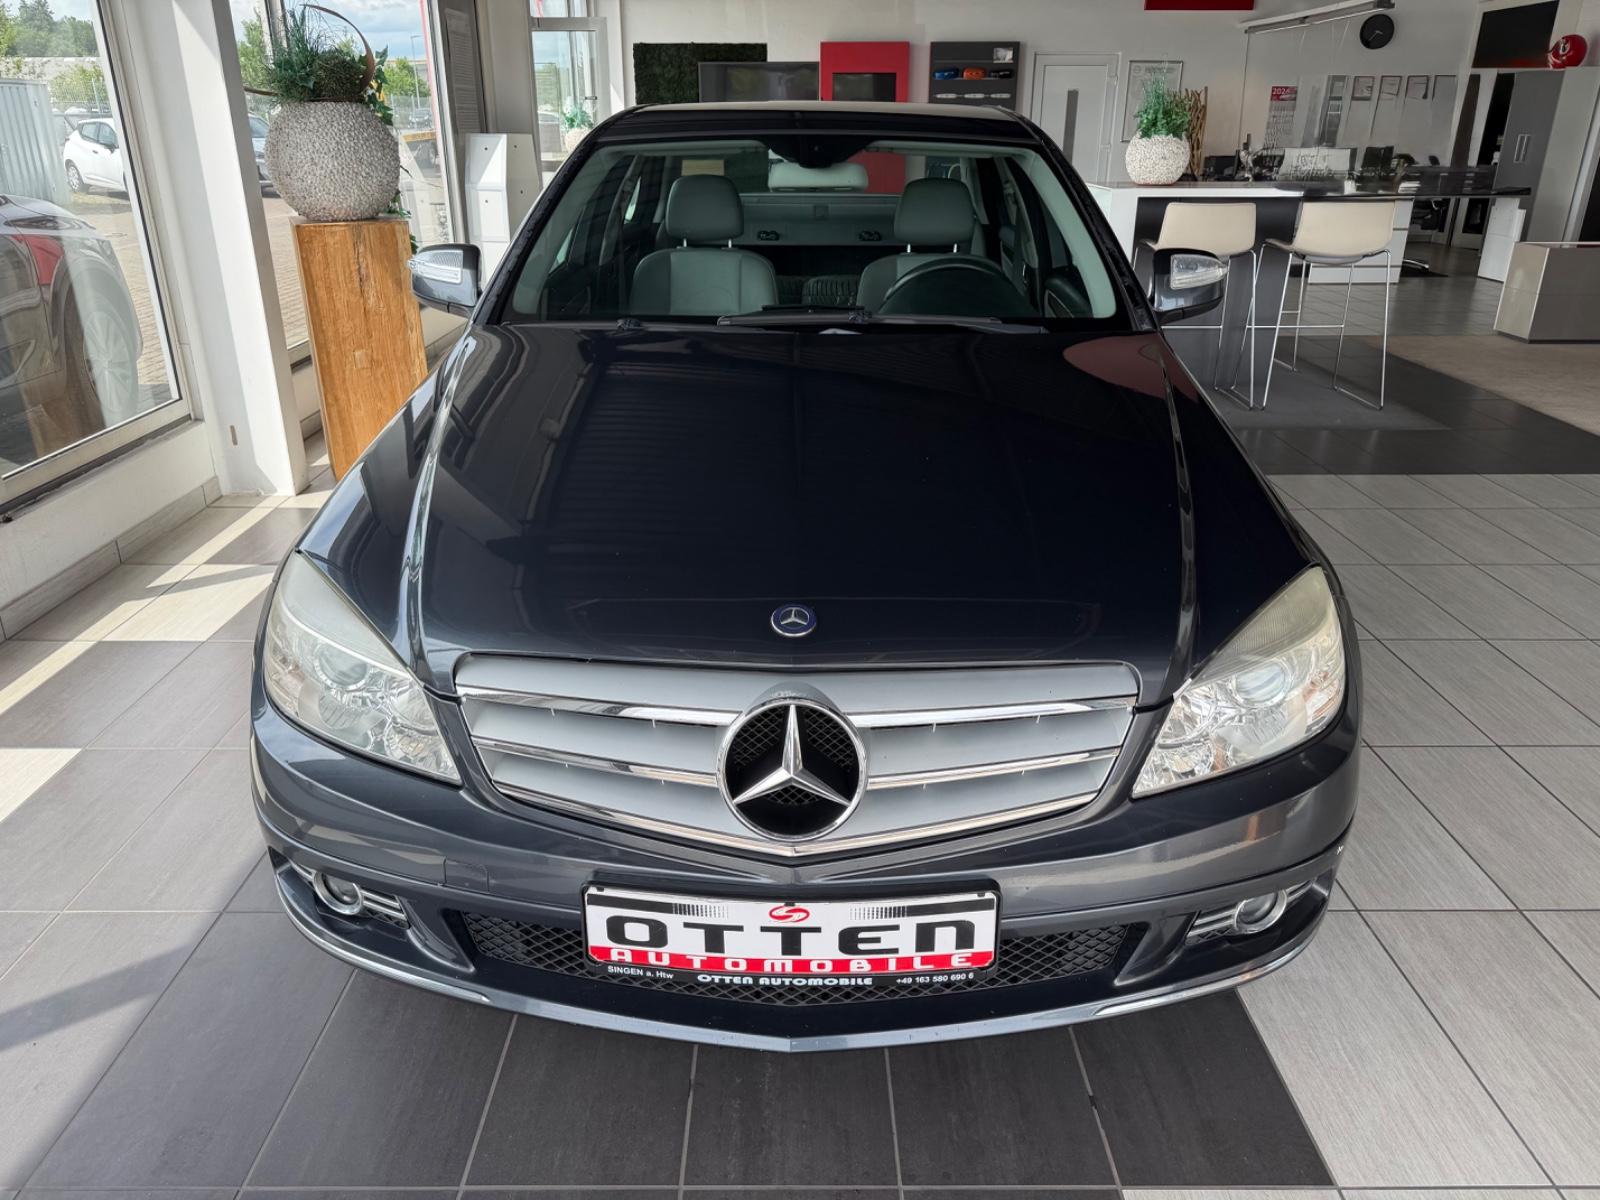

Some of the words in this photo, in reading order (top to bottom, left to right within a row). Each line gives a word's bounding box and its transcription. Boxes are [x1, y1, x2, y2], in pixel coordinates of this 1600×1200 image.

[606, 915, 976, 957] OTTEN
[610, 948, 973, 973] AUTOMOBILE
[607, 965, 643, 977] SINGEN
[697, 974, 753, 986] OTTEN
[758, 976, 873, 987] AUTOMOBILE
[896, 977, 912, 985] +49
[915, 976, 930, 984] 163
